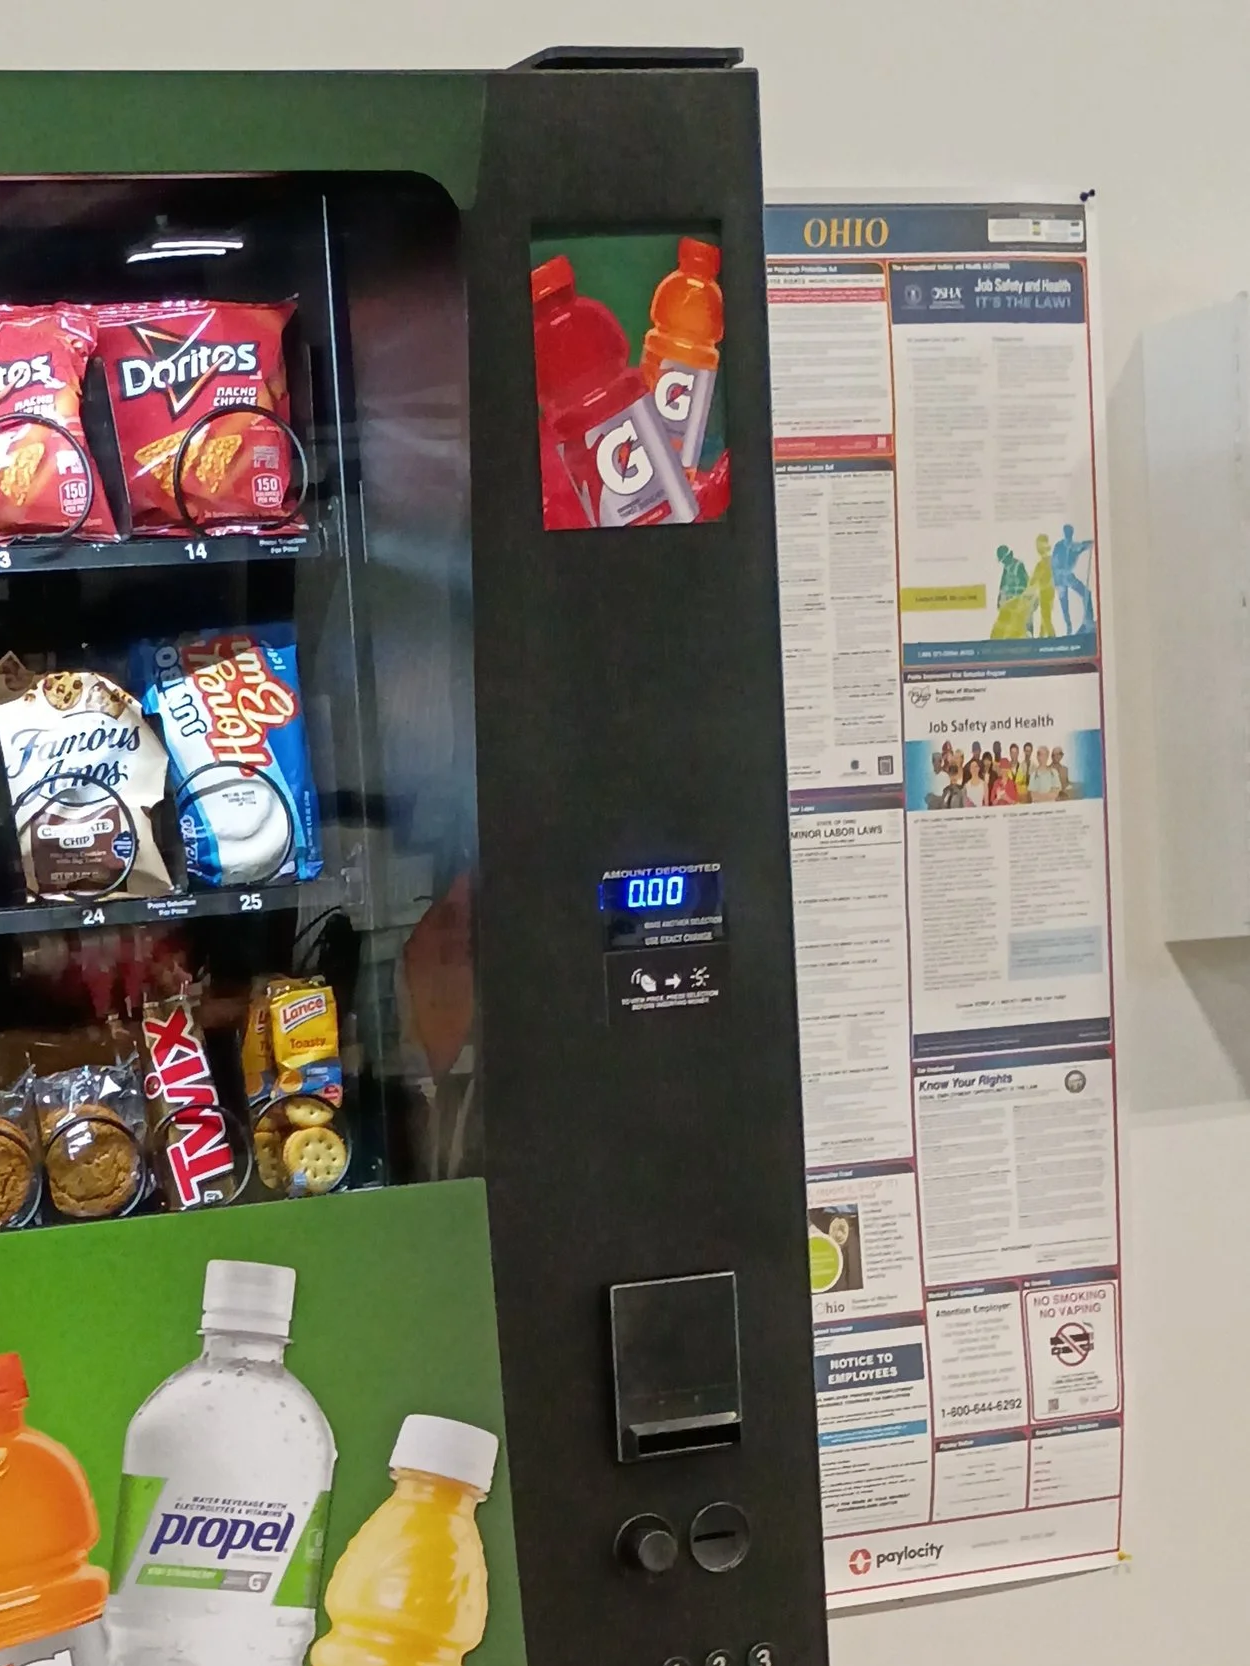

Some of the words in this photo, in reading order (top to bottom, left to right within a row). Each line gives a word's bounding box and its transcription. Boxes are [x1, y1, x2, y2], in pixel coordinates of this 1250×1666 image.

[803, 217, 889, 248] OHIO
[974, 278, 994, 293] Job
[994, 278, 1023, 294] Safety
[1024, 278, 1041, 293] and
[1041, 279, 1072, 293] Health
[1005, 295, 1033, 309] THE
[121, 341, 257, 398] Doritos
[216, 386, 257, 397] NACHO
[654, 370, 695, 421] G
[596, 419, 654, 495] G
[64, 483, 87, 498] 150
[256, 477, 278, 491] 150
[185, 543, 208, 560] 14
[234, 638, 295, 729] Bun
[189, 643, 274, 776] Honey
[929, 721, 948, 733] Job
[951, 718, 987, 733] Safety
[990, 716, 1011, 729] and
[1015, 714, 1054, 729] Health
[7, 722, 141, 779] Famous
[790, 829, 822, 840] MINOR
[824, 826, 855, 838] LABOR
[857, 824, 883, 836] LAWS
[62, 836, 91, 848] CHIP
[603, 867, 652, 880] AMOUNT
[654, 863, 721, 876] DEPOSITED
[628, 876, 684, 908] 0.00
[239, 893, 263, 911] 25
[81, 908, 105, 925] 24
[282, 995, 325, 1025] Lance
[289, 1035, 327, 1050] Toasty
[919, 1079, 949, 1092] Know
[952, 1076, 977, 1089] Your
[978, 1073, 1013, 1090] Rights
[1033, 1296, 1050, 1306] NO
[1053, 1289, 1106, 1305] SMOKING
[936, 1305, 971, 1318] Attention
[1039, 1308, 1056, 1319] NO
[1058, 1303, 1101, 1316] VAPING
[830, 1354, 874, 1370] NOTICE
[876, 1352, 893, 1364] TO
[828, 1366, 898, 1385] EMPLOYEES
[174, 1502, 235, 1514] ELECTROLYTES
[245, 1509, 283, 1518] VITAMINS
[192, 1496, 220, 1504] WATER
[221, 1498, 264, 1509] BEVERAGE
[266, 1503, 288, 1511] WITH
[148, 1512, 295, 1560] propel
[876, 1542, 944, 1568] paylocity
